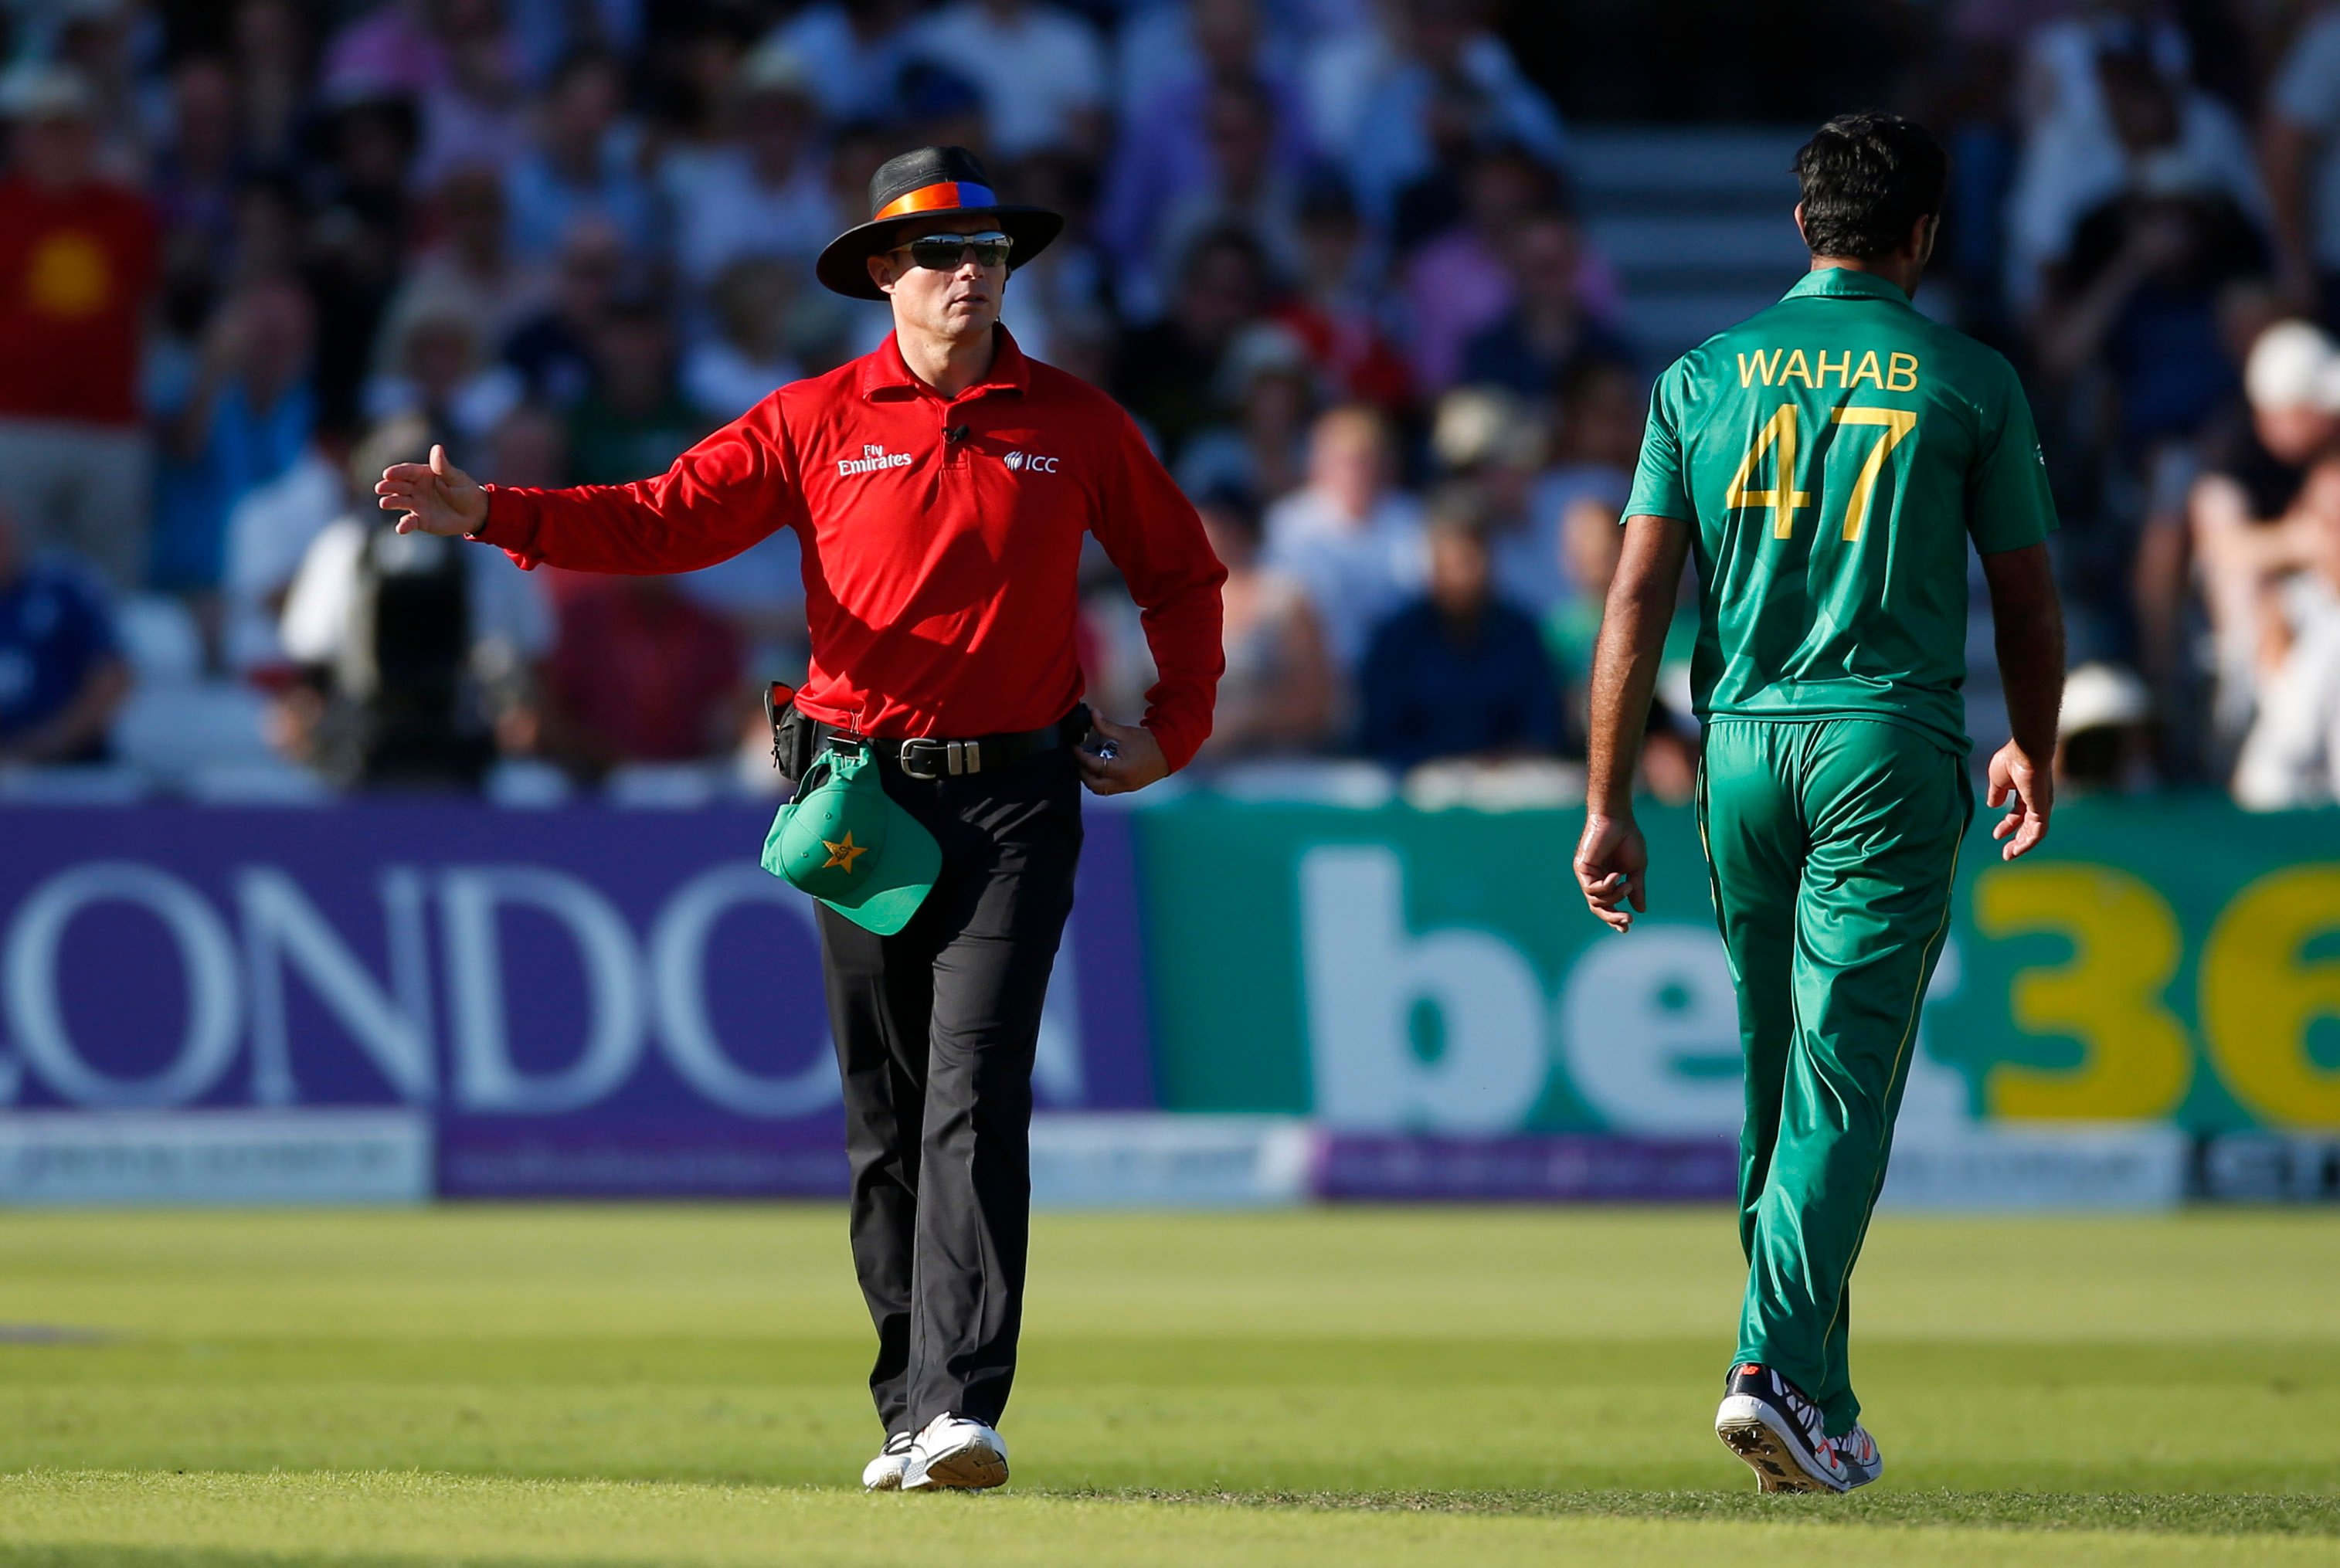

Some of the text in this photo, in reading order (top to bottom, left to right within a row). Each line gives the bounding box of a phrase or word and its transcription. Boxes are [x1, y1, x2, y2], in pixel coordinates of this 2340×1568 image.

[1737, 349, 1919, 392] WAHAB
[837, 453, 912, 476] Emirates
[863, 444, 883, 457] Fly
[1025, 454, 1059, 473] ICC
[1726, 403, 1917, 541] 47
[0, 860, 1083, 1114] ONDO
